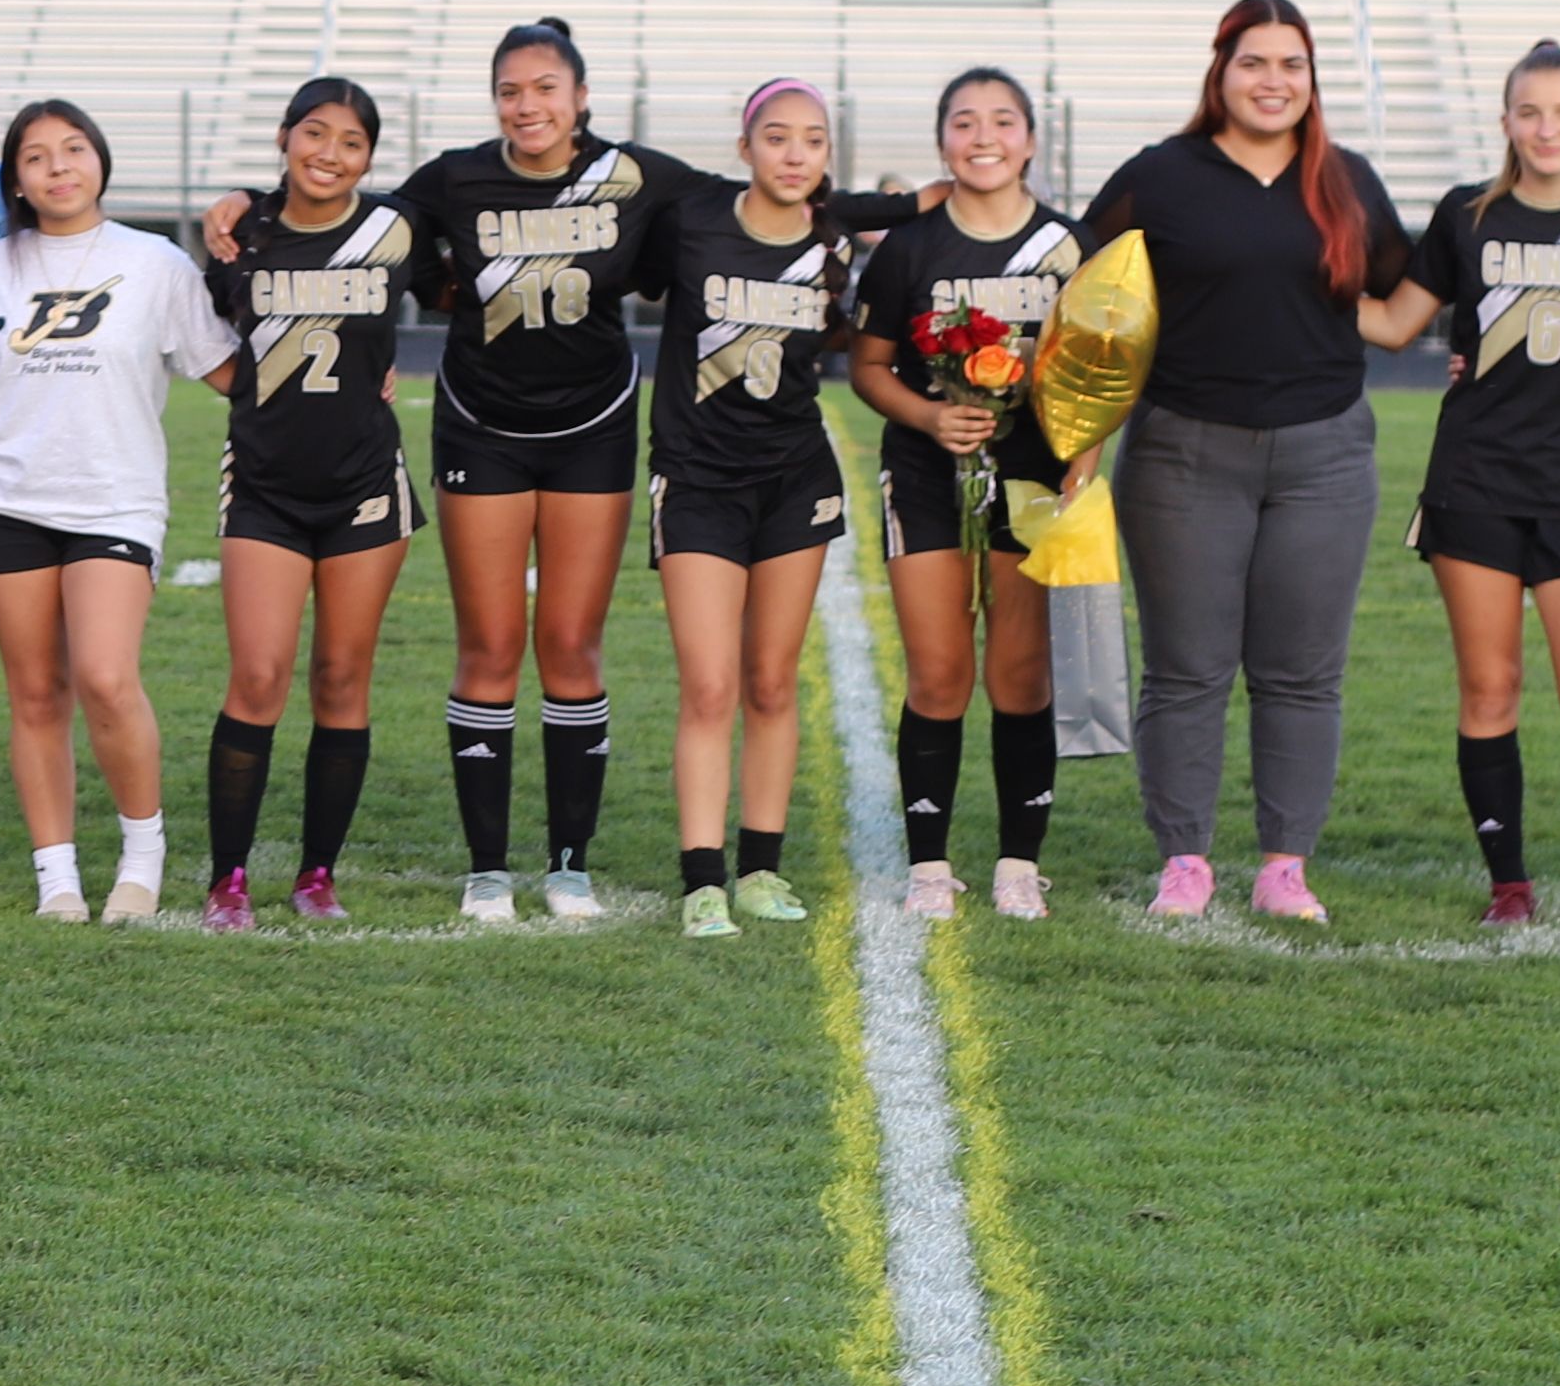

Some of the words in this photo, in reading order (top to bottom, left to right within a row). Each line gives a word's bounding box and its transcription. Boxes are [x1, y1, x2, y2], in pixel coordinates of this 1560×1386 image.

[476, 201, 620, 257] CANNERS
[251, 266, 389, 316] CANNERS
[510, 267, 592, 330] 18
[704, 274, 831, 332] CANNERS
[21, 362, 51, 375] Field
[54, 361, 102, 376] Hockey
[31, 346, 96, 361] Biglerville
[301, 329, 341, 393] 2
[744, 338, 784, 401] 9
